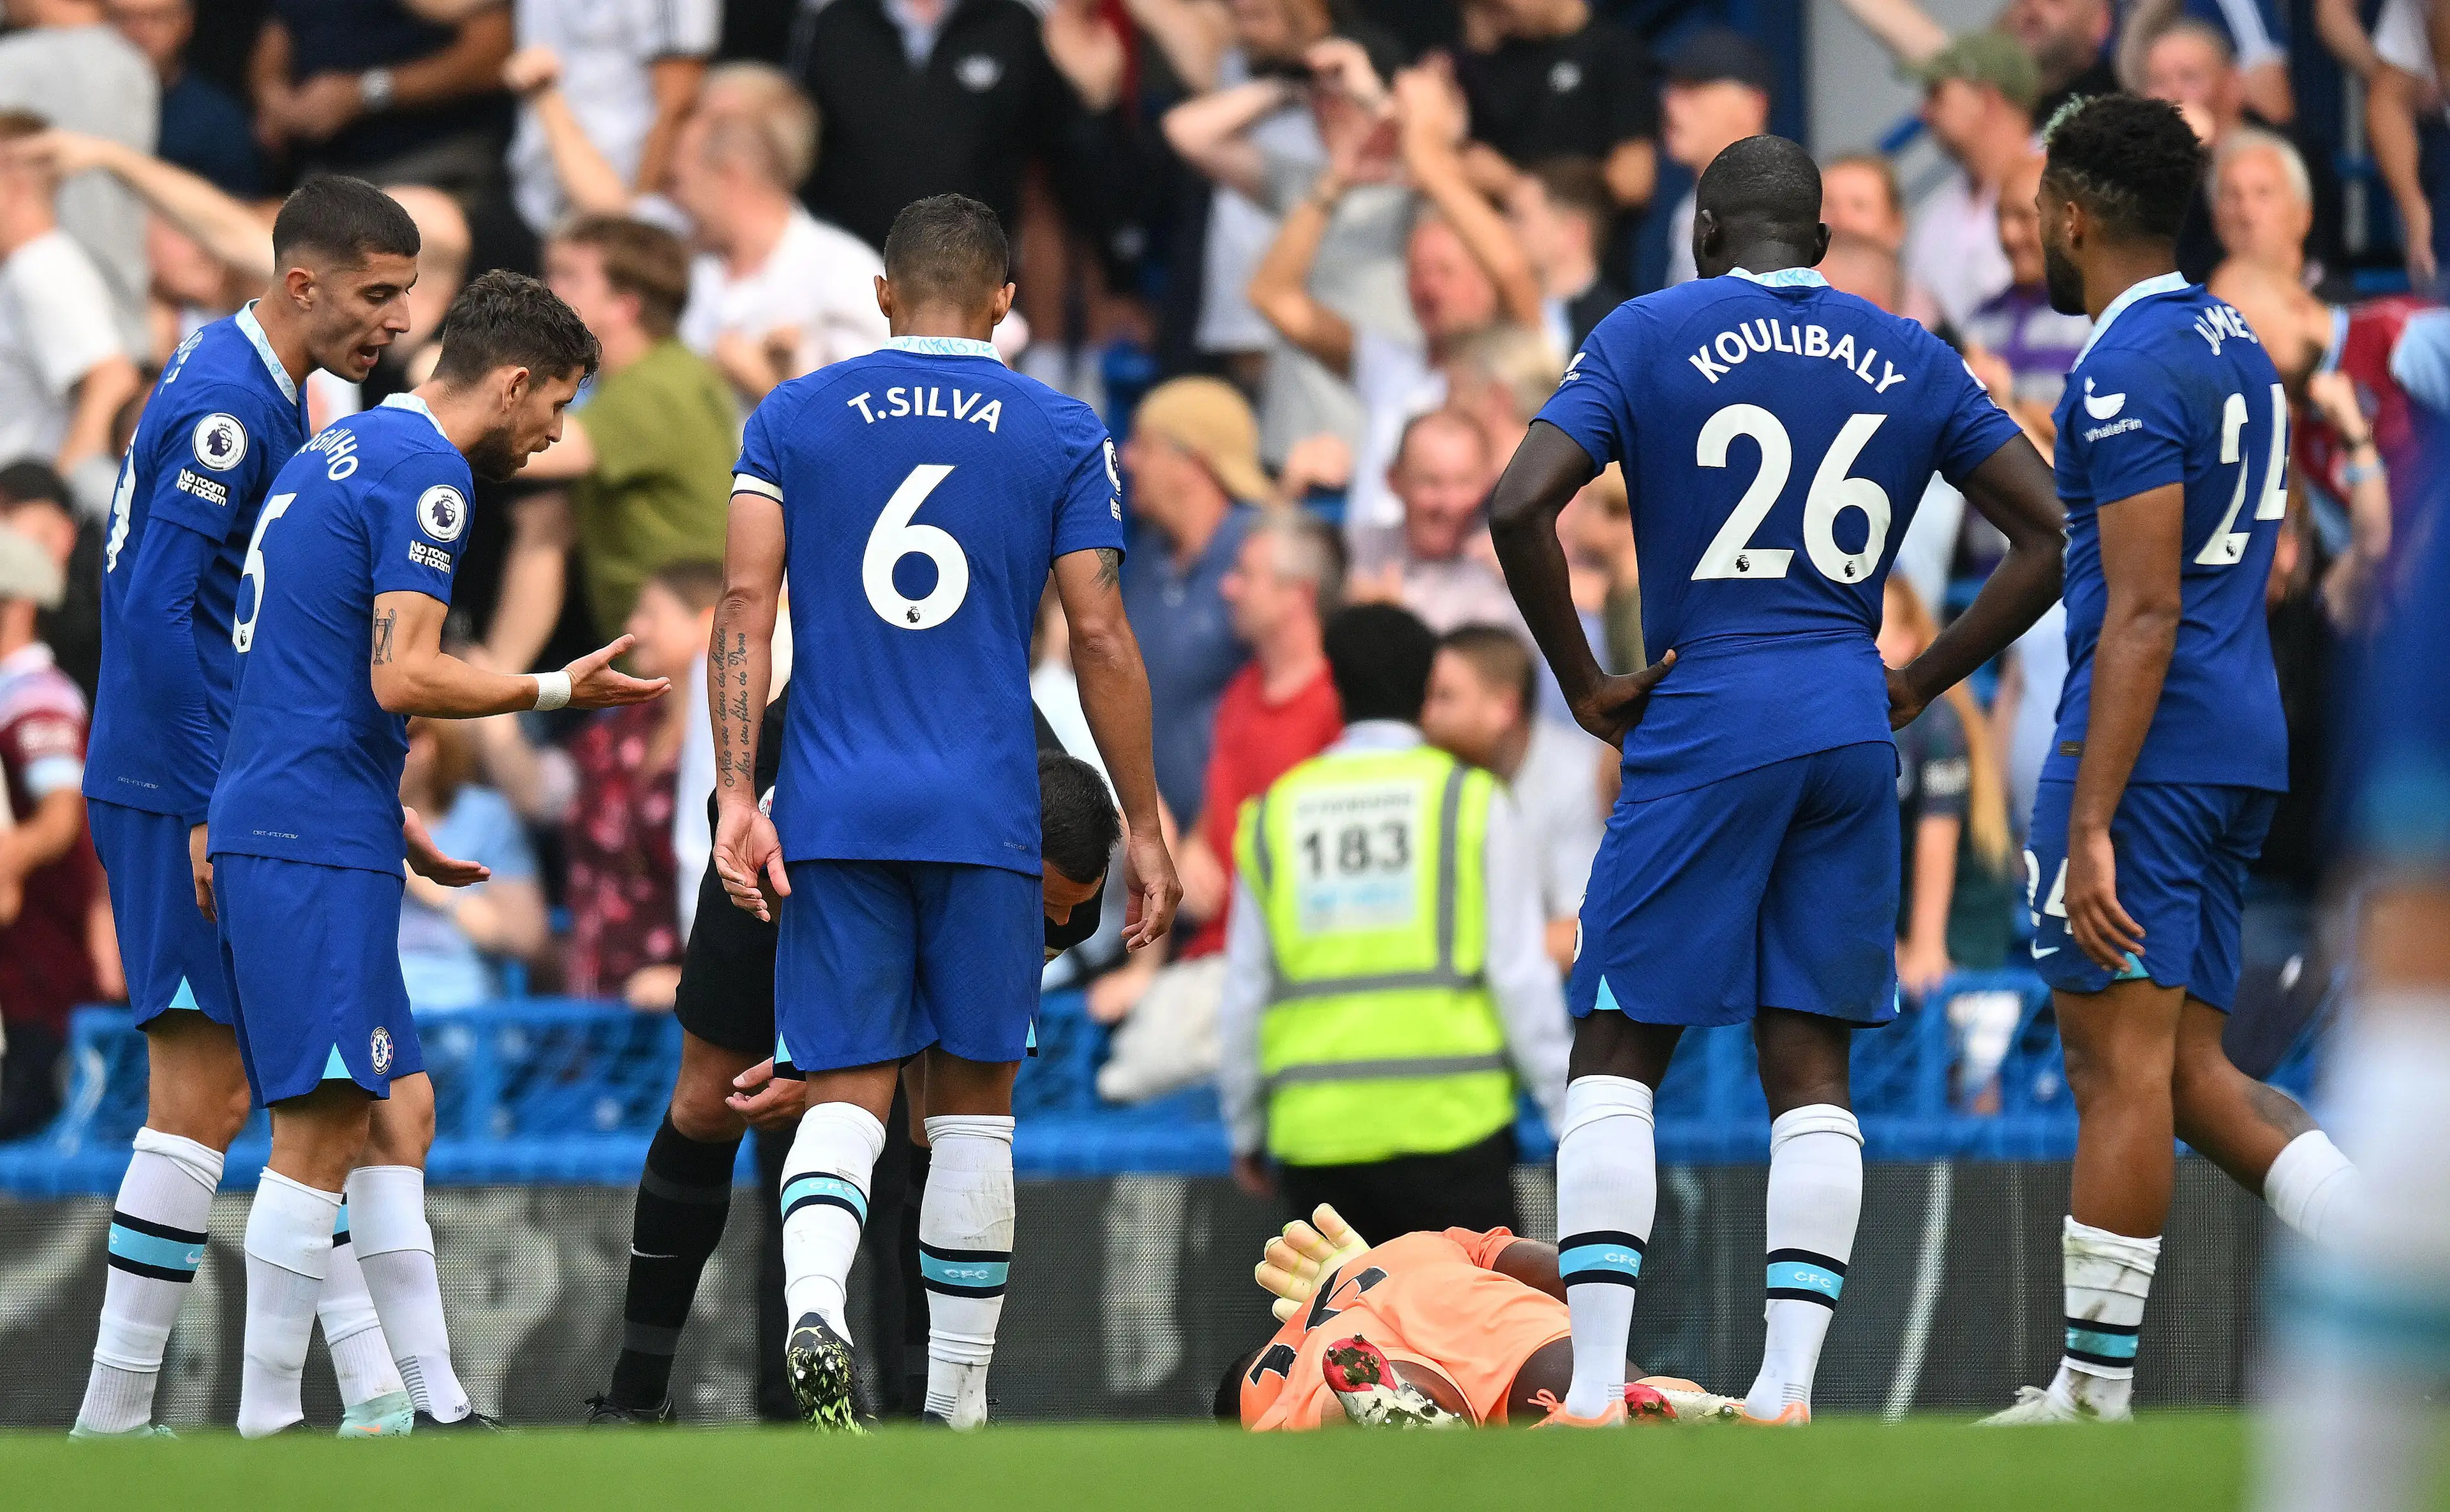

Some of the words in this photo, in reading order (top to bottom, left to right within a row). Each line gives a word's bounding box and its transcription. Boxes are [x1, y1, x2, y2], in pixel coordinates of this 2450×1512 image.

[1688, 318, 1906, 394] KOULIBALY
[847, 387, 1003, 433] T.SILVA
[176, 479, 192, 493] for
[191, 486, 226, 507] racism
[179, 468, 195, 483] No
[195, 476, 226, 496] room
[1691, 403, 1892, 585] 26
[410, 540, 427, 555] No
[427, 545, 450, 563] room
[861, 464, 970, 630] 6
[408, 551, 425, 564] for
[424, 556, 451, 574] racism
[1301, 820, 1410, 880] 183
[1603, 1252, 1637, 1268] CFC
[1793, 1271, 1832, 1289] CFC
